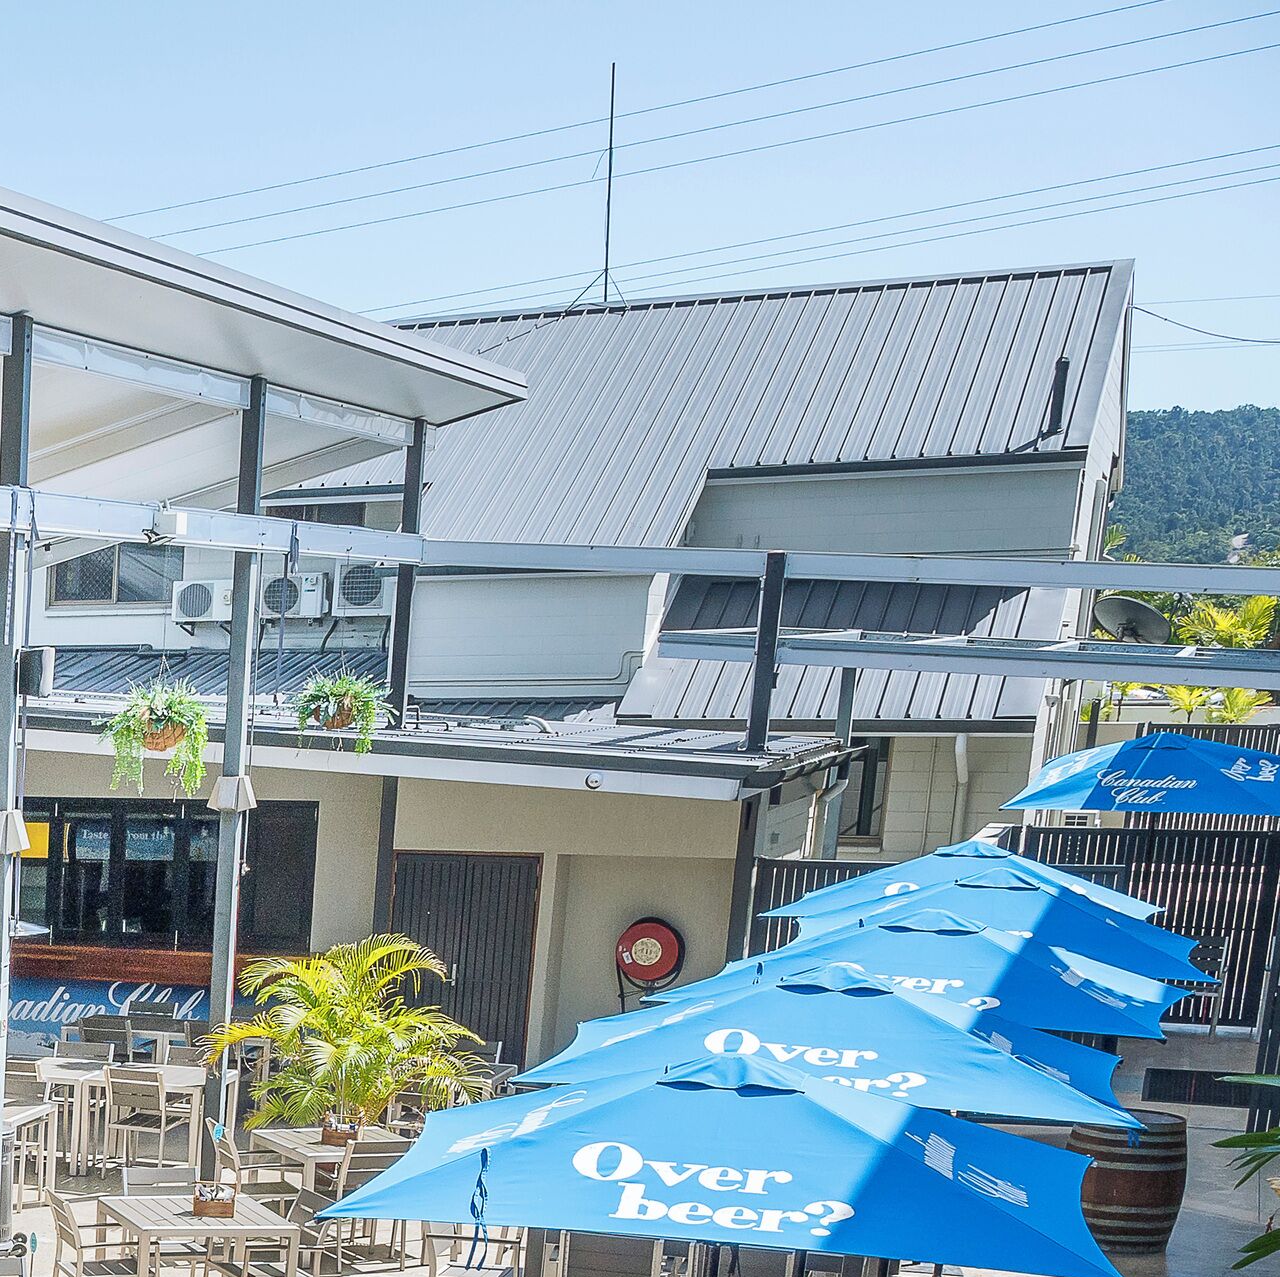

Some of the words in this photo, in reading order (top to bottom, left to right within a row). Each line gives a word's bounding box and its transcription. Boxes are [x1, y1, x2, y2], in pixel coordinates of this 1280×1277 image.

[1097, 768, 1198, 789] Canadian
[1111, 787, 1167, 804] Club
[704, 1028, 879, 1068] Over
[572, 1141, 793, 1195] Over
[608, 1181, 856, 1237] beer?
